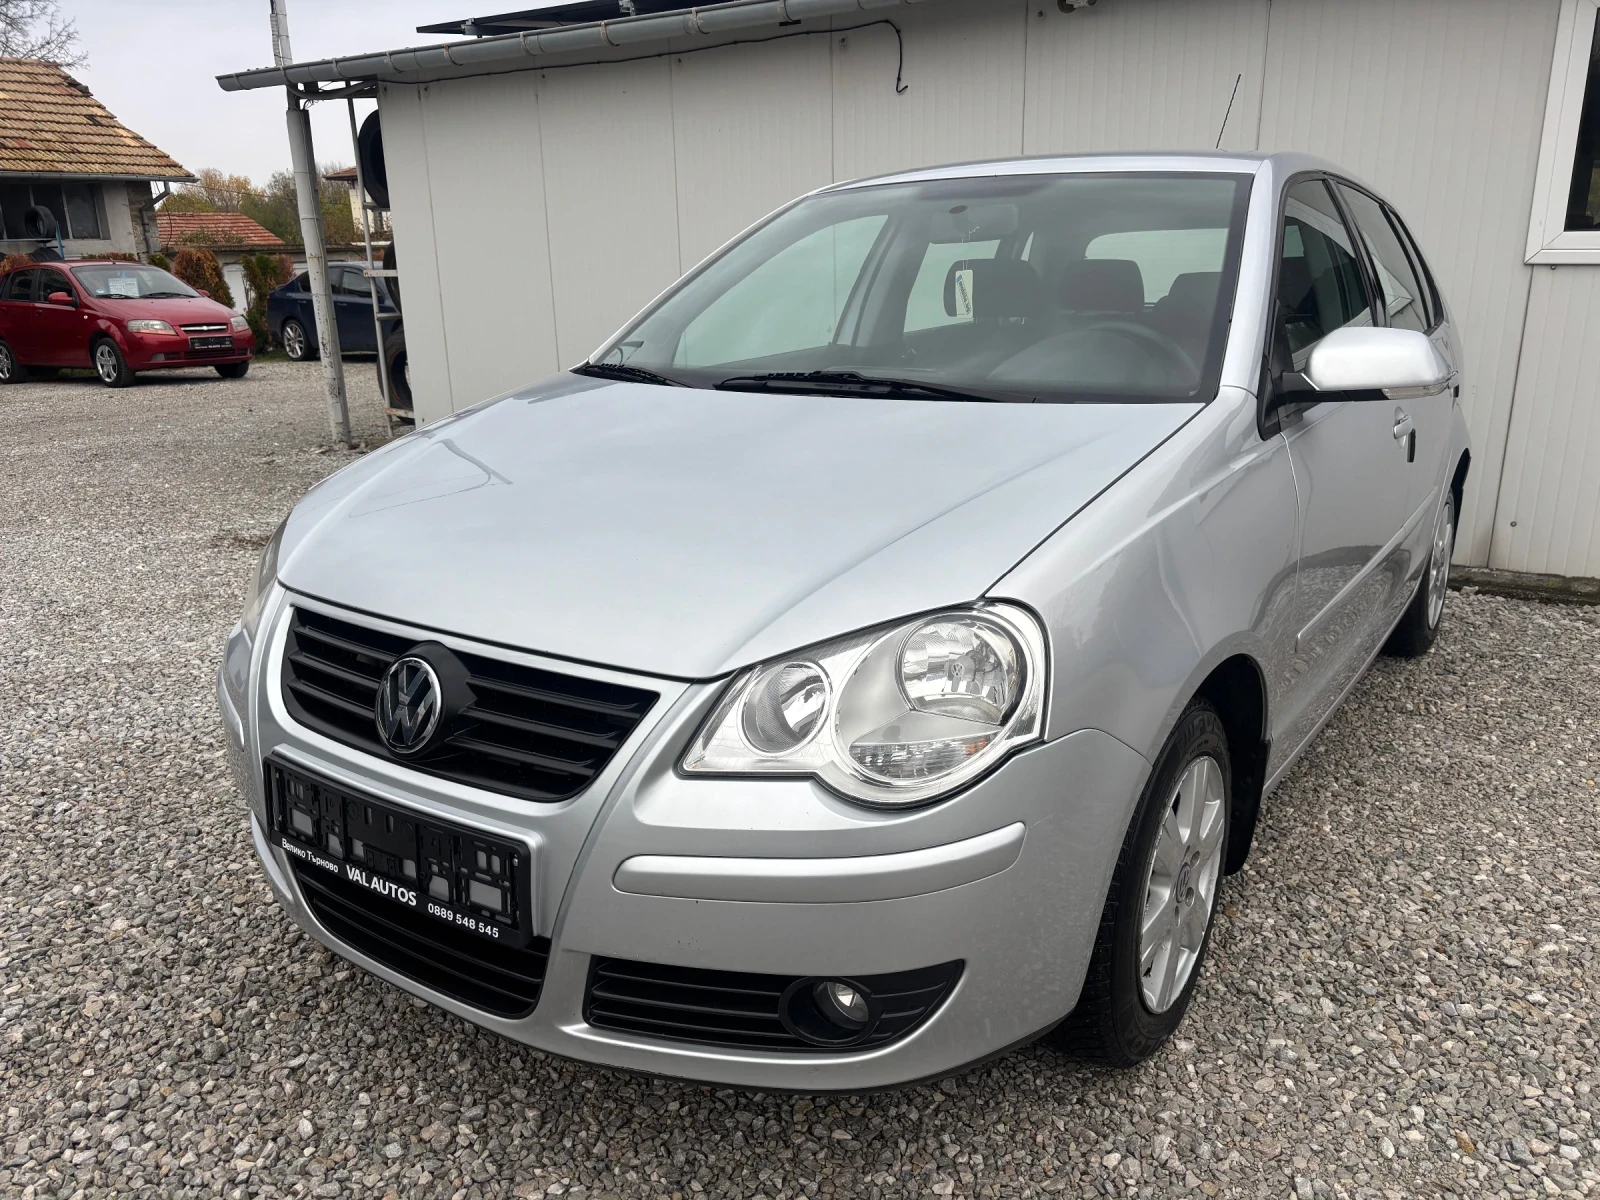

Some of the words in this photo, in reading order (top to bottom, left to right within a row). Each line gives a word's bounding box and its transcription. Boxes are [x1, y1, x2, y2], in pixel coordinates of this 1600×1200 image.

[281, 837, 306, 859] Велико
[306, 850, 339, 873] Търново
[345, 864, 370, 887] VAL
[370, 875, 417, 906] AUTOS
[427, 902, 454, 921] 0889
[455, 913, 476, 930] 548
[478, 921, 499, 938] 545
